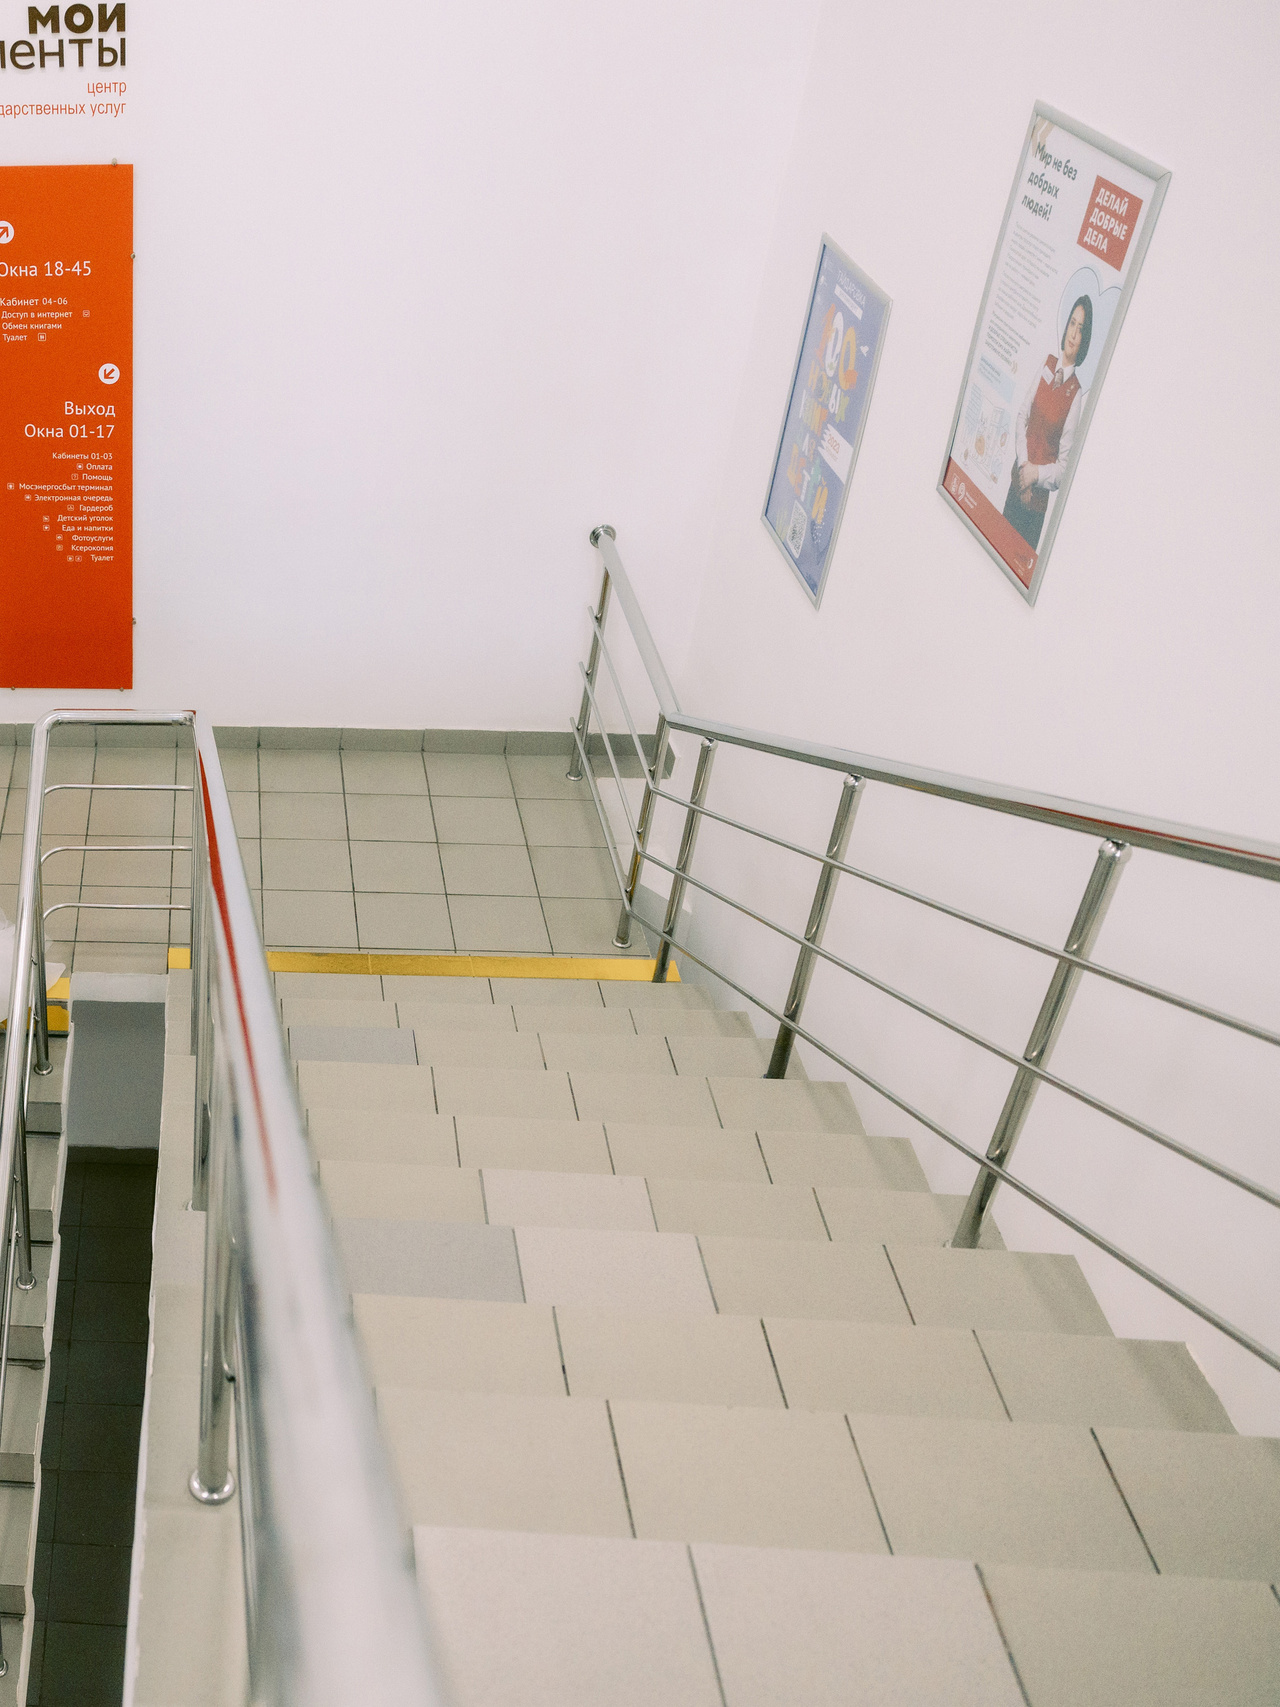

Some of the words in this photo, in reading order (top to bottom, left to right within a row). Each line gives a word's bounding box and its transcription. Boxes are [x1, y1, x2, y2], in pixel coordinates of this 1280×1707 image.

[87, 81, 127, 97] центр
[90, 101, 126, 117] услуг
[1034, 141, 1052, 169] Мир
[1052, 157, 1062, 172] не
[1062, 159, 1078, 181] без
[1027, 172, 1060, 199] добрых
[1095, 187, 1129, 217] ДЕЛАЙ
[1021, 195, 1052, 222] людей!
[1089, 207, 1128, 241] ДОБРЫЕ
[1083, 227, 1108, 254] ДЕЛА
[44, 260, 92, 277] 18-45
[0, 297, 39, 306] Кабинет
[42, 297, 68, 305] 04-06
[1, 311, 28, 320] Доступ
[37, 311, 73, 319] интернет
[2, 322, 28, 330] Обмен
[2, 333, 27, 343] Туалет
[64, 401, 116, 418] Выход
[24, 424, 64, 438] Окна
[69, 424, 115, 438] 01-17
[52, 452, 89, 460] Кабинеты
[91, 452, 113, 460] 01-03
[86, 463, 113, 471] Оплата
[82, 473, 113, 481] Помощь
[19, 483, 76, 491] Мосэнергосбыт
[77, 484, 113, 492] терминал
[34, 494, 81, 502] Электронная
[79, 504, 114, 512] Гардероб
[57, 514, 88, 522] Детский
[89, 515, 114, 523] уголок
[61, 524, 75, 532] Еда
[71, 534, 114, 542] Фотоуслуги
[71, 544, 114, 552] Ксерокопия
[90, 554, 114, 562] Туалет
